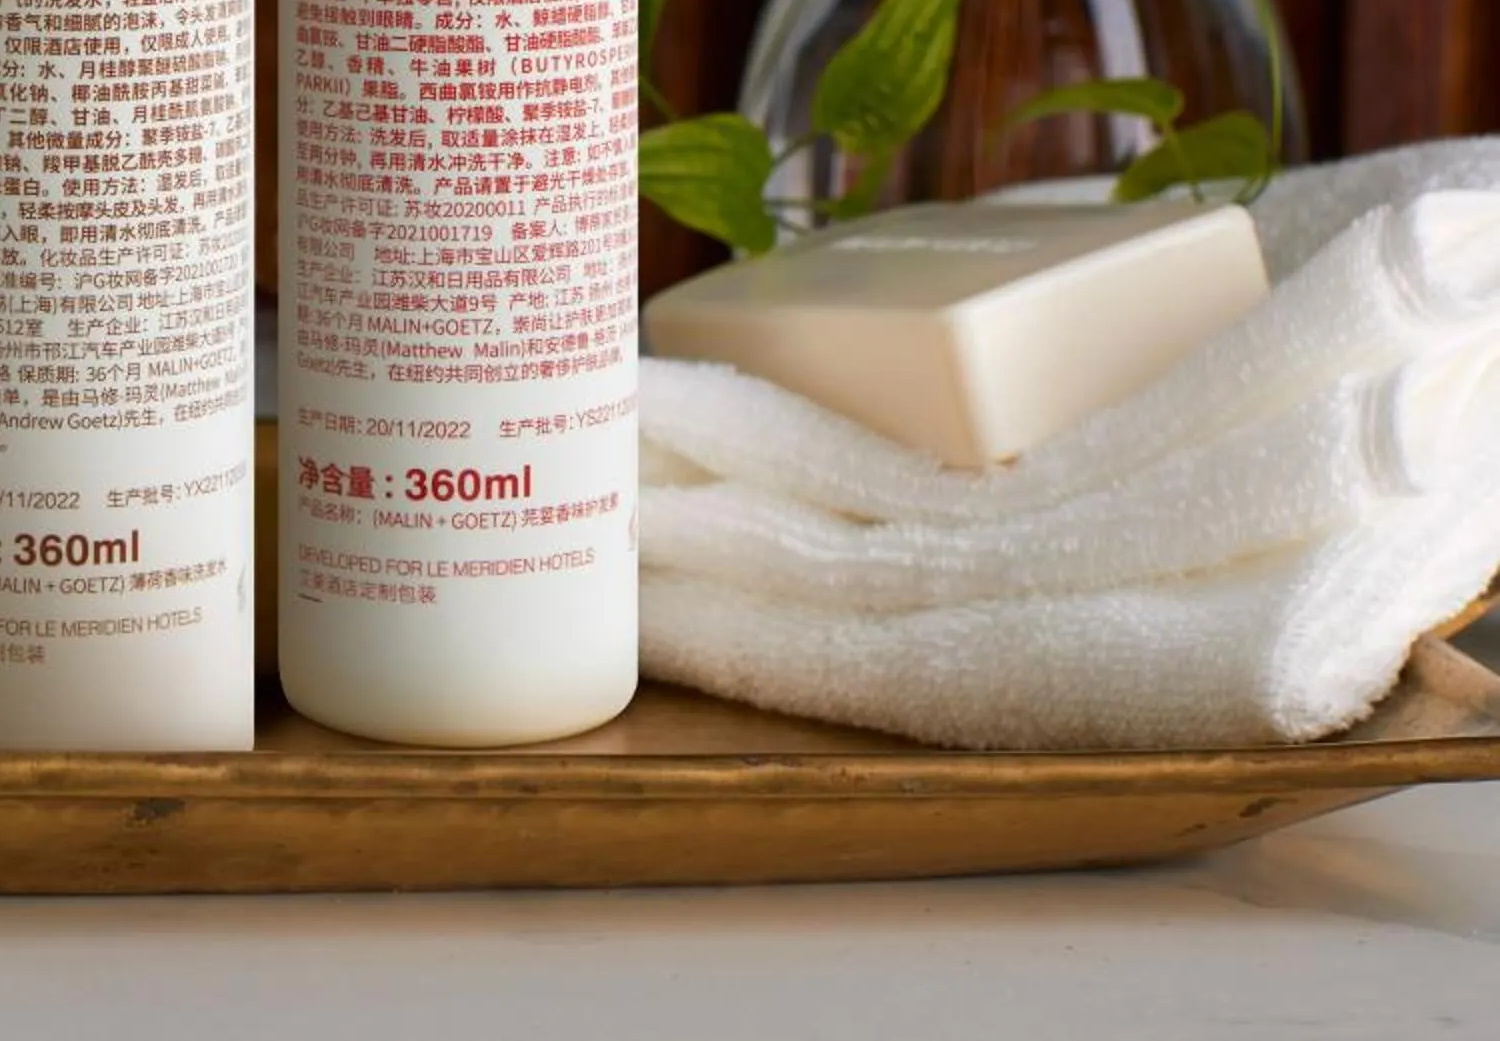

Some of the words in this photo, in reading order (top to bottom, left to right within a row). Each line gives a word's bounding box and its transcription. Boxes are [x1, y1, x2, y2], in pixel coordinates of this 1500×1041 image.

[367, 417, 471, 439] 20/11/2022
[386, 558, 422, 576] FOR
[427, 561, 446, 577] LE
[453, 557, 534, 577] MERIDIEN
[539, 546, 596, 572] HOTELS
[35, 620, 55, 637] LE
[62, 615, 143, 637] MERIDIEN
[147, 605, 202, 632] HOTELS
